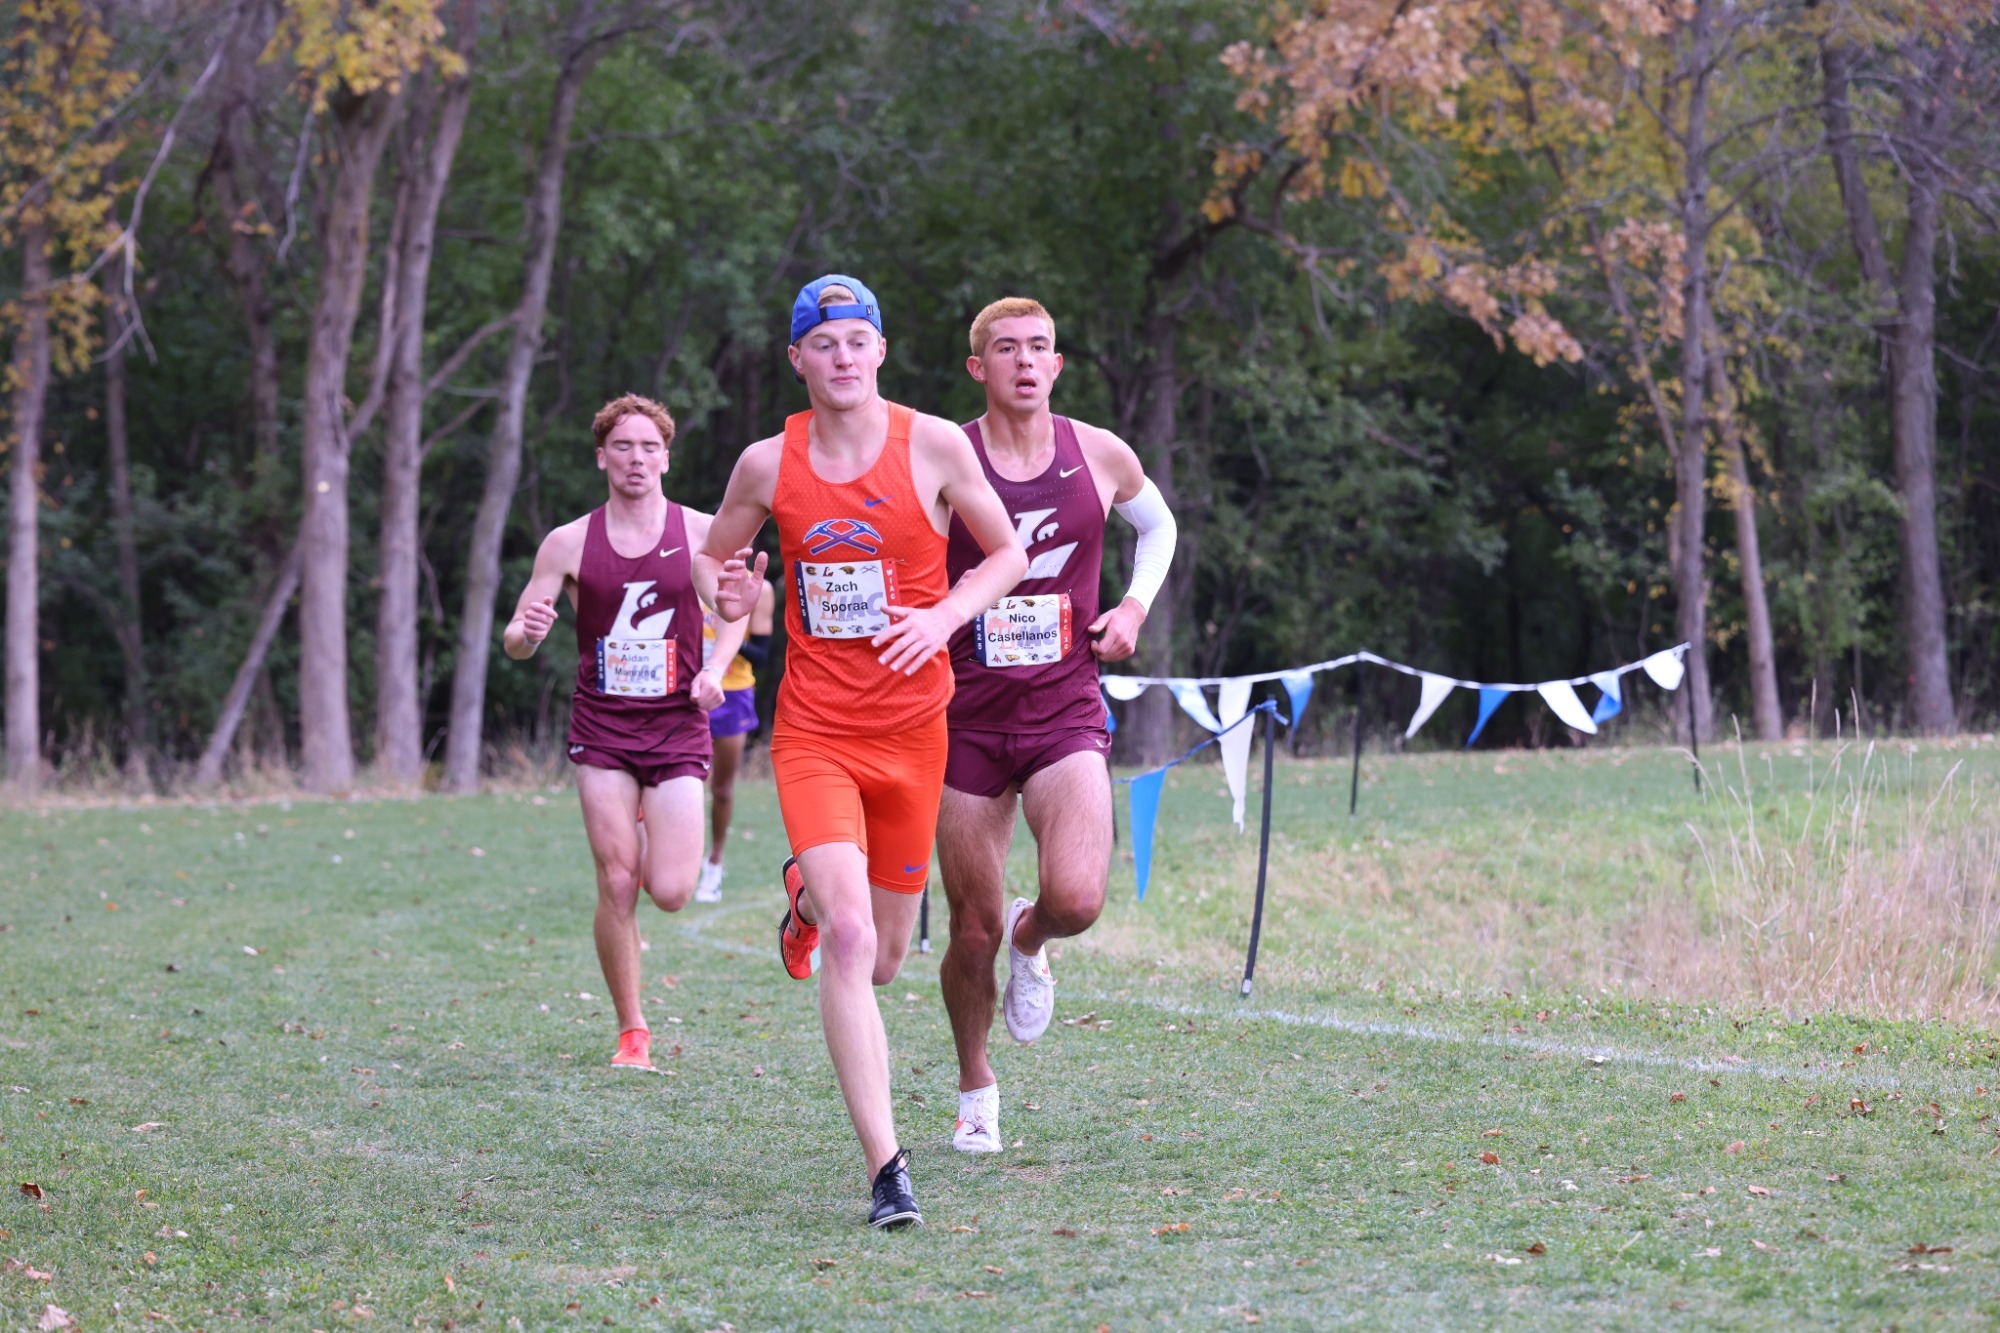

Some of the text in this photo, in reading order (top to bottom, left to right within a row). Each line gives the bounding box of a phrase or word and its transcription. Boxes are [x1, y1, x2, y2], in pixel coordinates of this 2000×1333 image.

[826, 581, 858, 593] Zach
[822, 601, 868, 614] Sporaa
[1009, 613, 1036, 623] Nico
[988, 629, 1058, 643] Castellanos
[621, 654, 650, 662] Aidan
[615, 667, 657, 678] Manning
